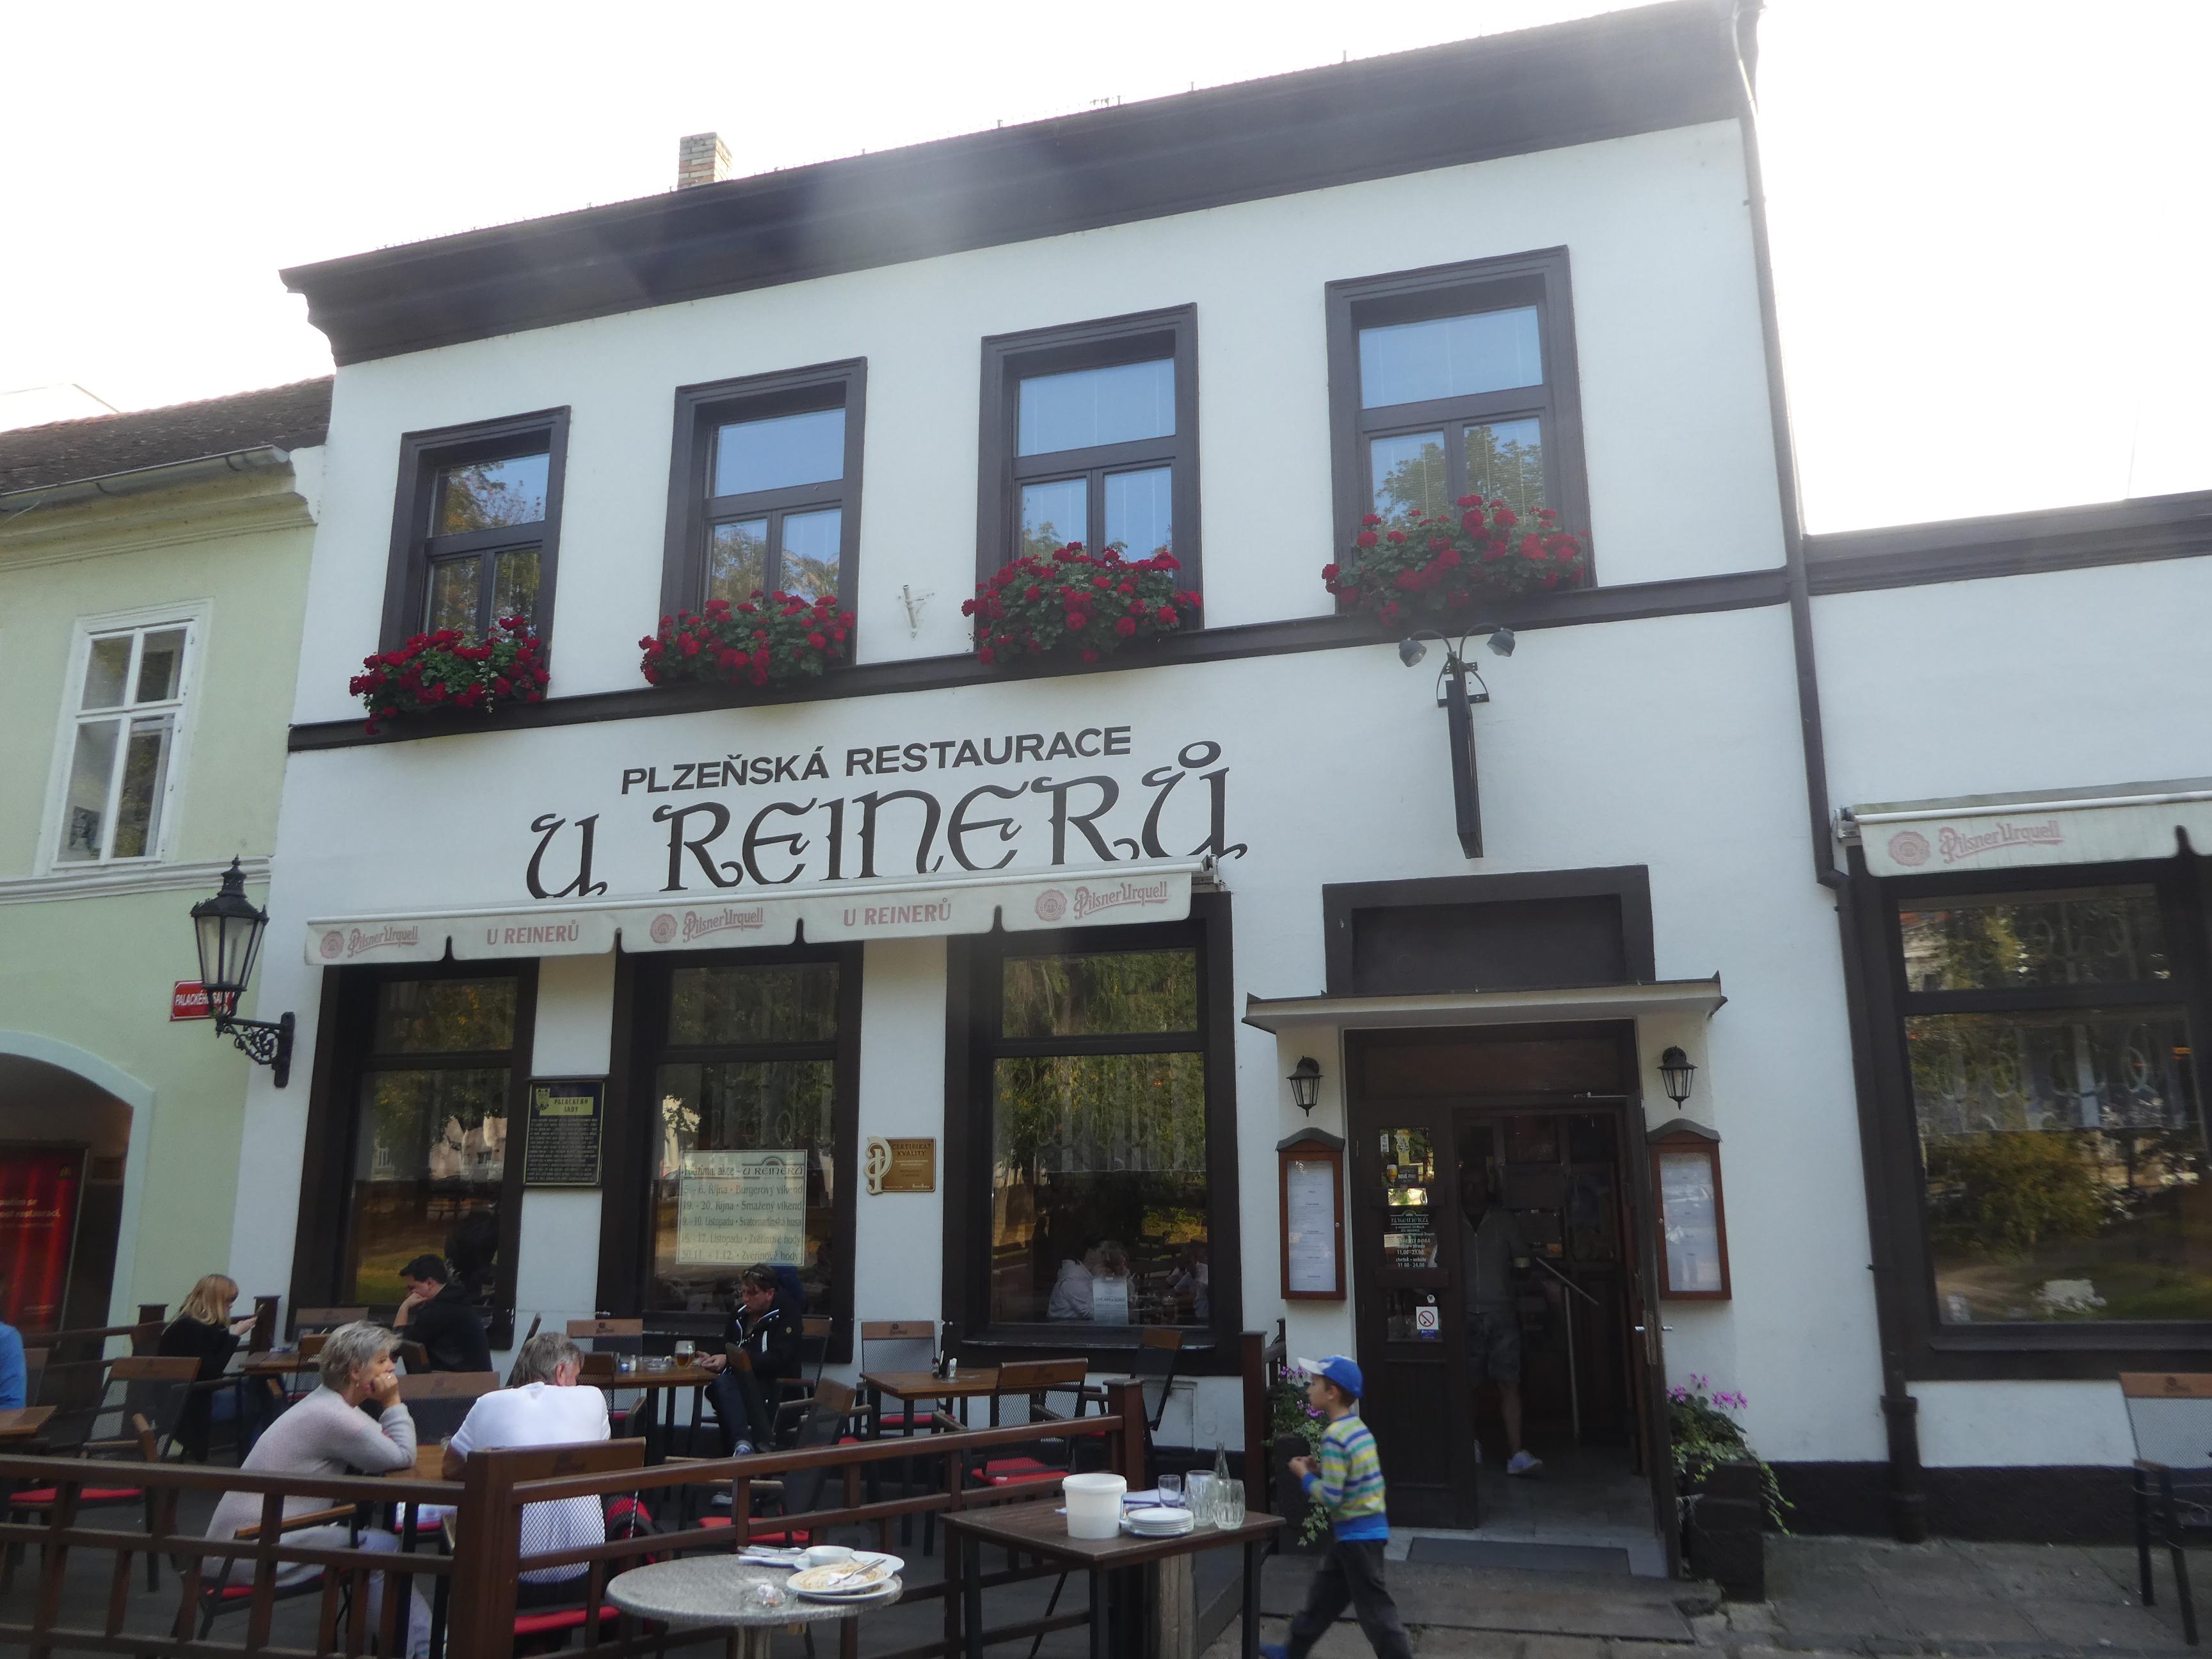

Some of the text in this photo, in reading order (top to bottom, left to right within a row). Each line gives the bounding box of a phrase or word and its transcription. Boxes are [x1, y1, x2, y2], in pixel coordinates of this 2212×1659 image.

[620, 726, 1132, 796] PLZEŇSKÁ RESTAURACE
[526, 741, 1248, 899] U REINERŮ
[1939, 820, 2060, 863] Pilsner Urquell
[843, 897, 952, 927] U REINERŮ
[1073, 881, 1167, 920] Pilsner Urquell
[348, 926, 419, 958] Pilsner Urquell
[486, 919, 579, 945] U REINERŮ
[682, 906, 764, 943] Pilsner Urquell
[175, 990, 209, 1006] PALACKÉH
